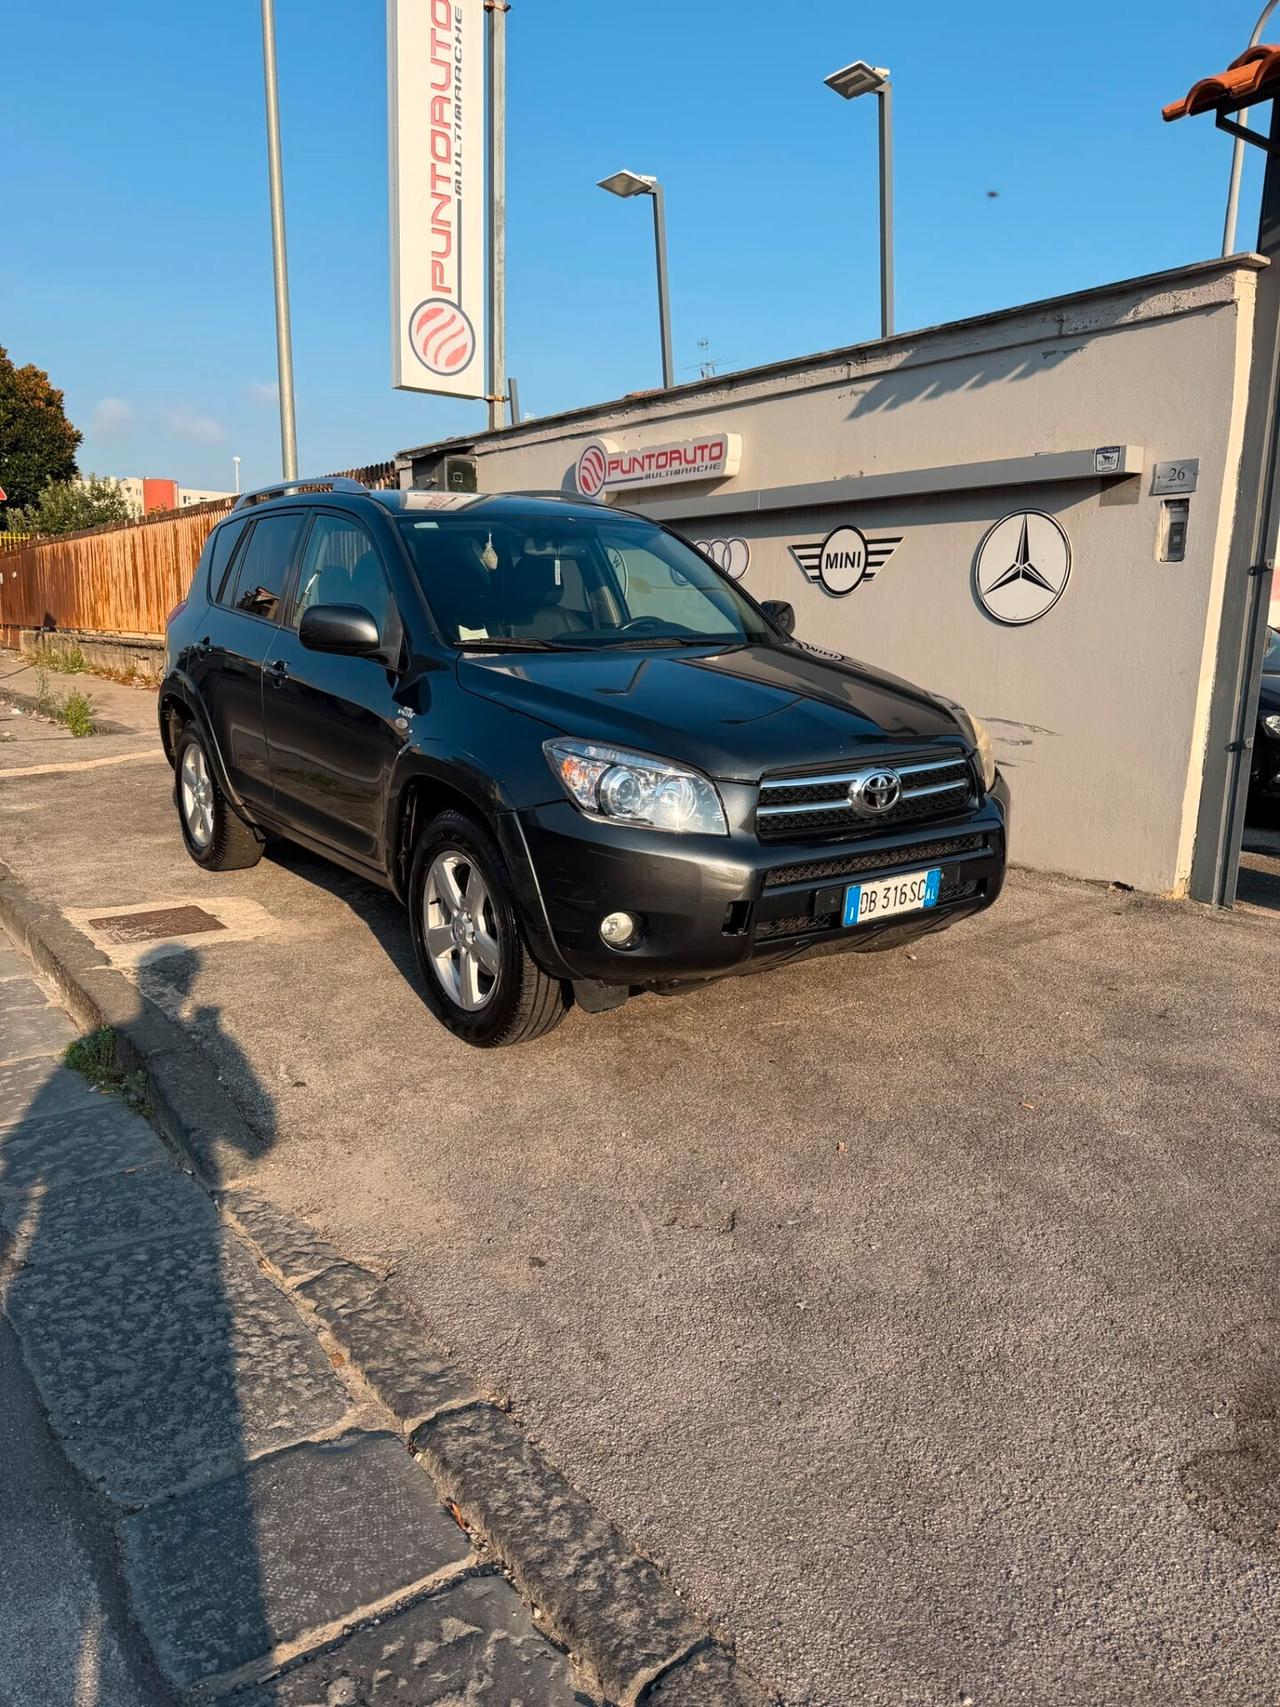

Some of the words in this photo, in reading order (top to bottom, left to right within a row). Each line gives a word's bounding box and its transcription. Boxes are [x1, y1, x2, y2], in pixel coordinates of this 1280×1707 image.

[454, 5, 463, 197] MULTIMARCHE
[431, 0, 452, 294] PUNTOAUTO
[608, 441, 723, 477] PUNTOAUTO
[644, 463, 721, 480] MULTIMARCHE
[1168, 466, 1185, 481] 26
[825, 551, 861, 570] MINI
[860, 890, 877, 915] DB
